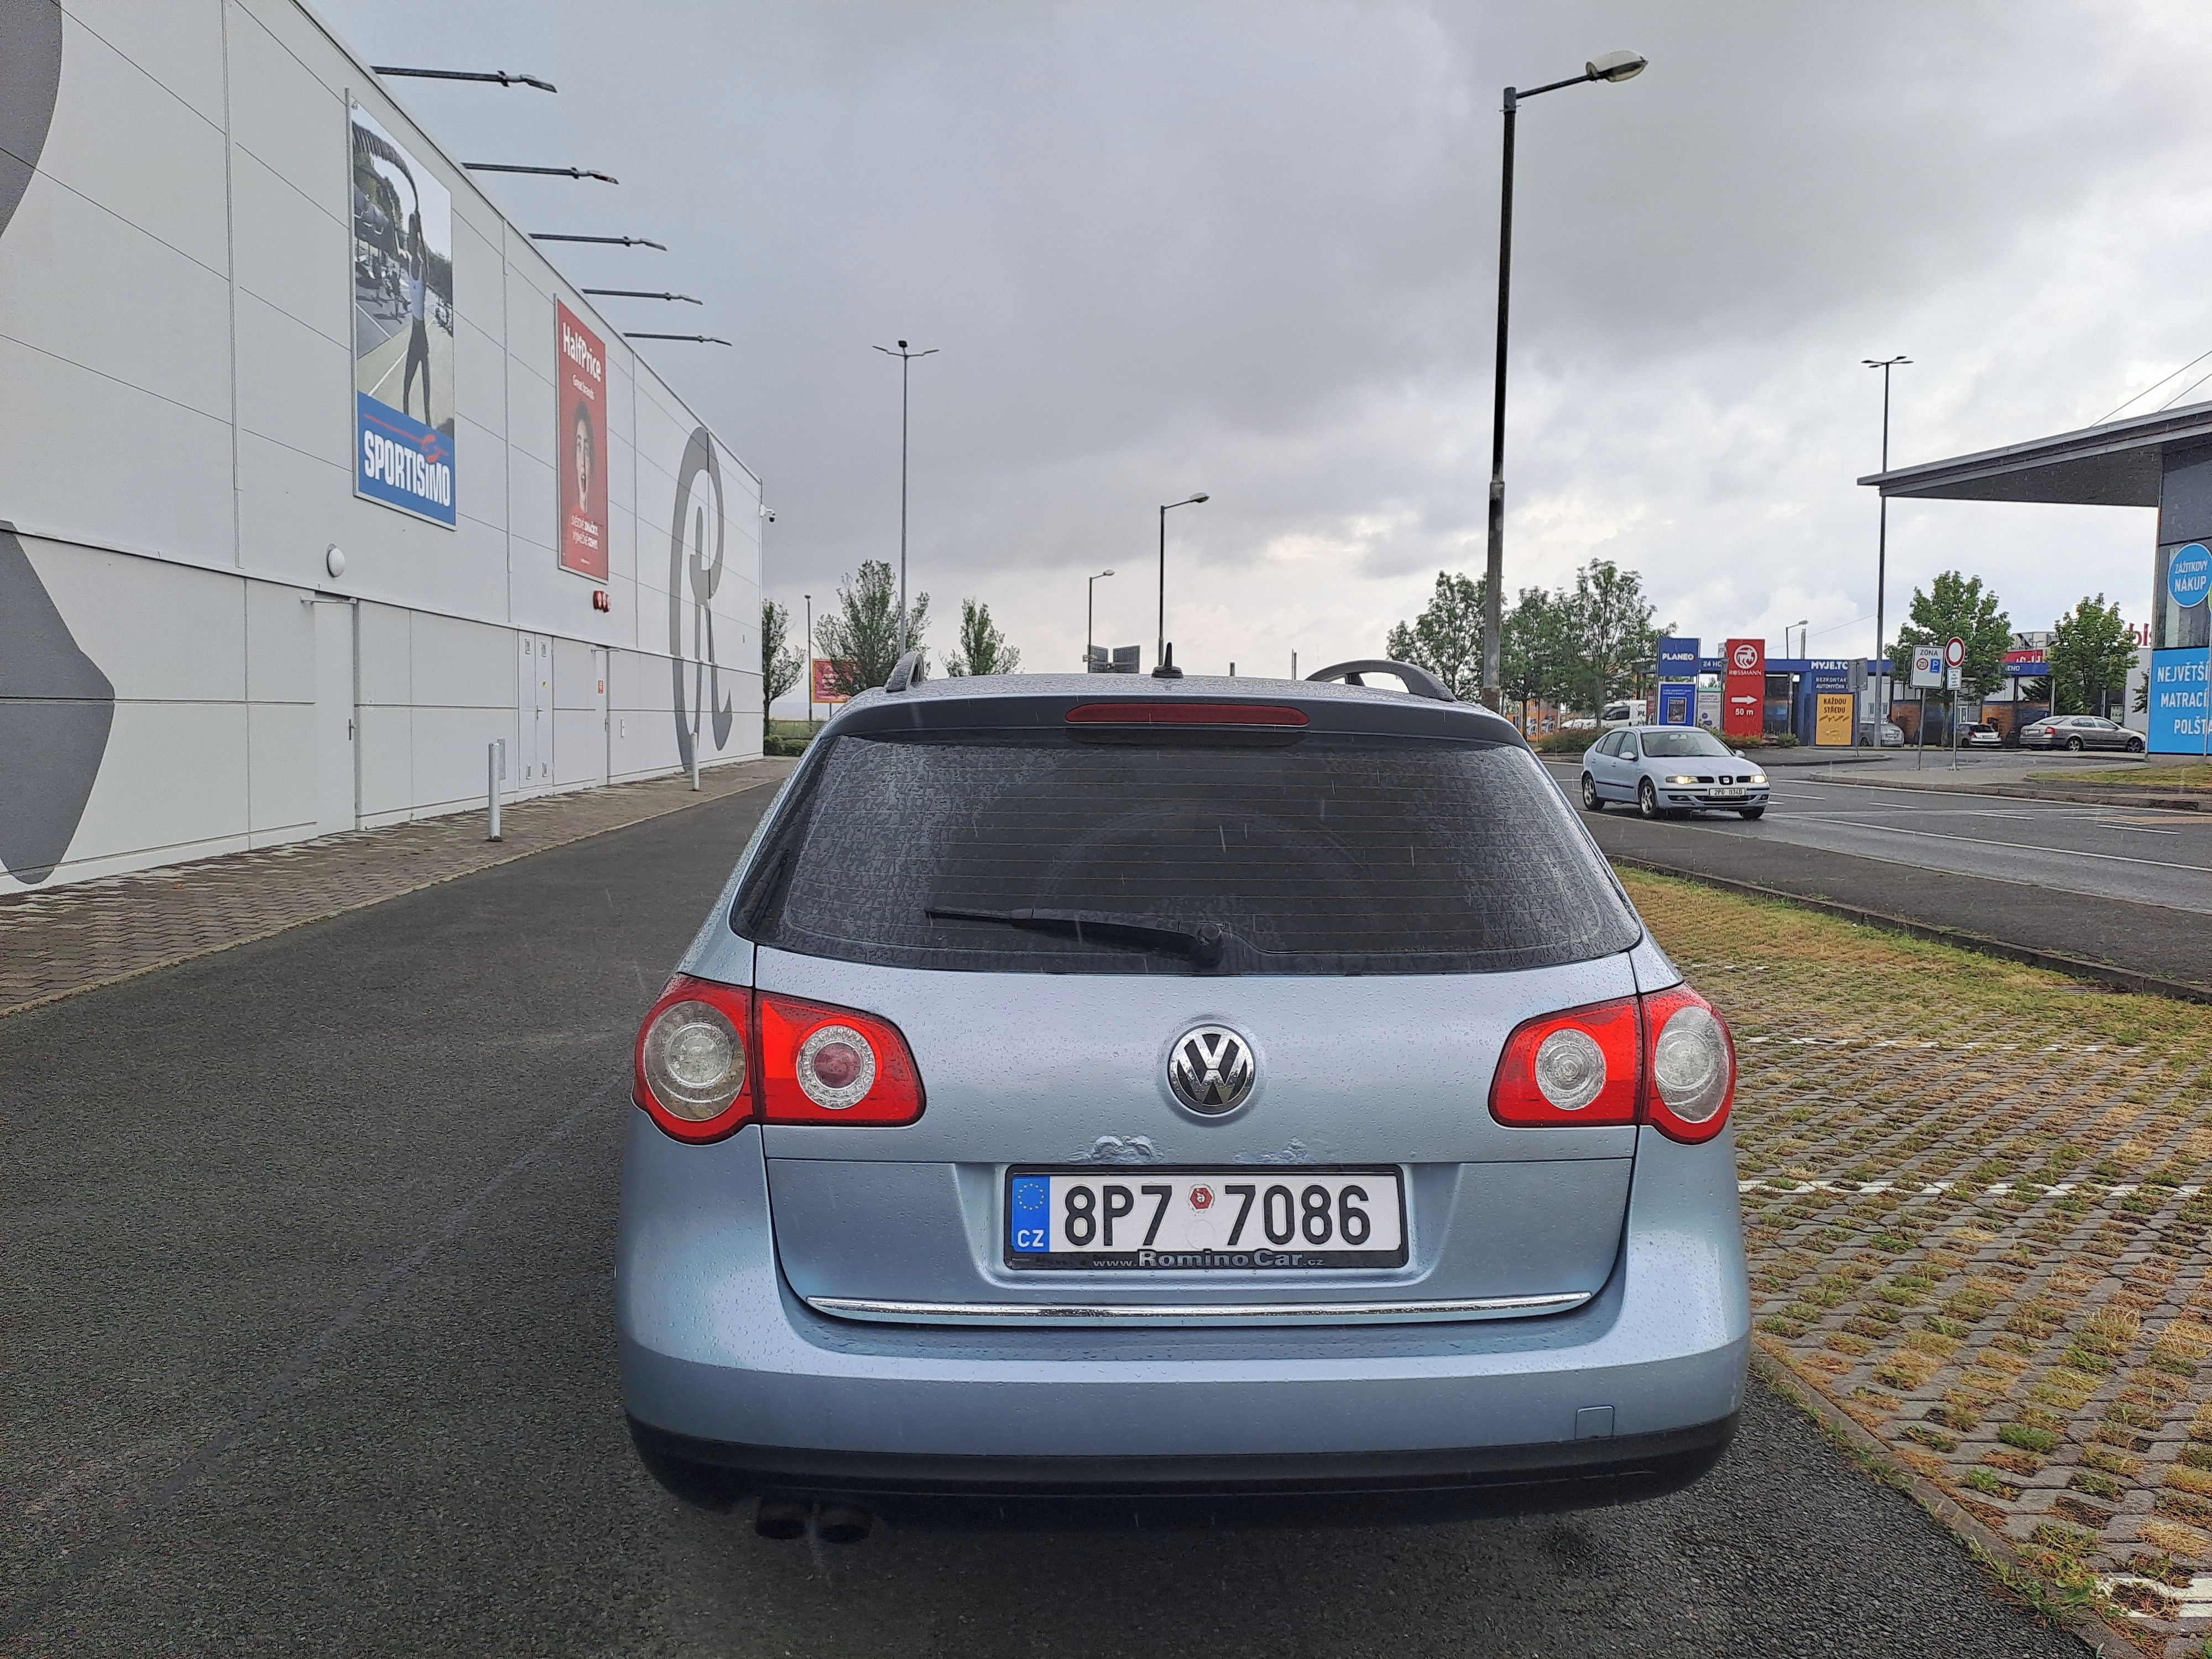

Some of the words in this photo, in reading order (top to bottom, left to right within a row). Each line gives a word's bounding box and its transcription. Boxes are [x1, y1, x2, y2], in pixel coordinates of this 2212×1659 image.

[563, 322, 602, 382] HalfPrice
[364, 430, 451, 507] SPORTISIMO
[2174, 558, 2208, 574] ZÁŽITKOVÝ
[2174, 574, 2206, 593] NÁKUP
[2129, 623, 2152, 646] bl
[2157, 661, 2209, 683] NEJVĚTŠÍ
[1065, 1185, 1172, 1246] 8P7
[1224, 1184, 1370, 1246] 7086
[1017, 1229, 1045, 1248] CZ
